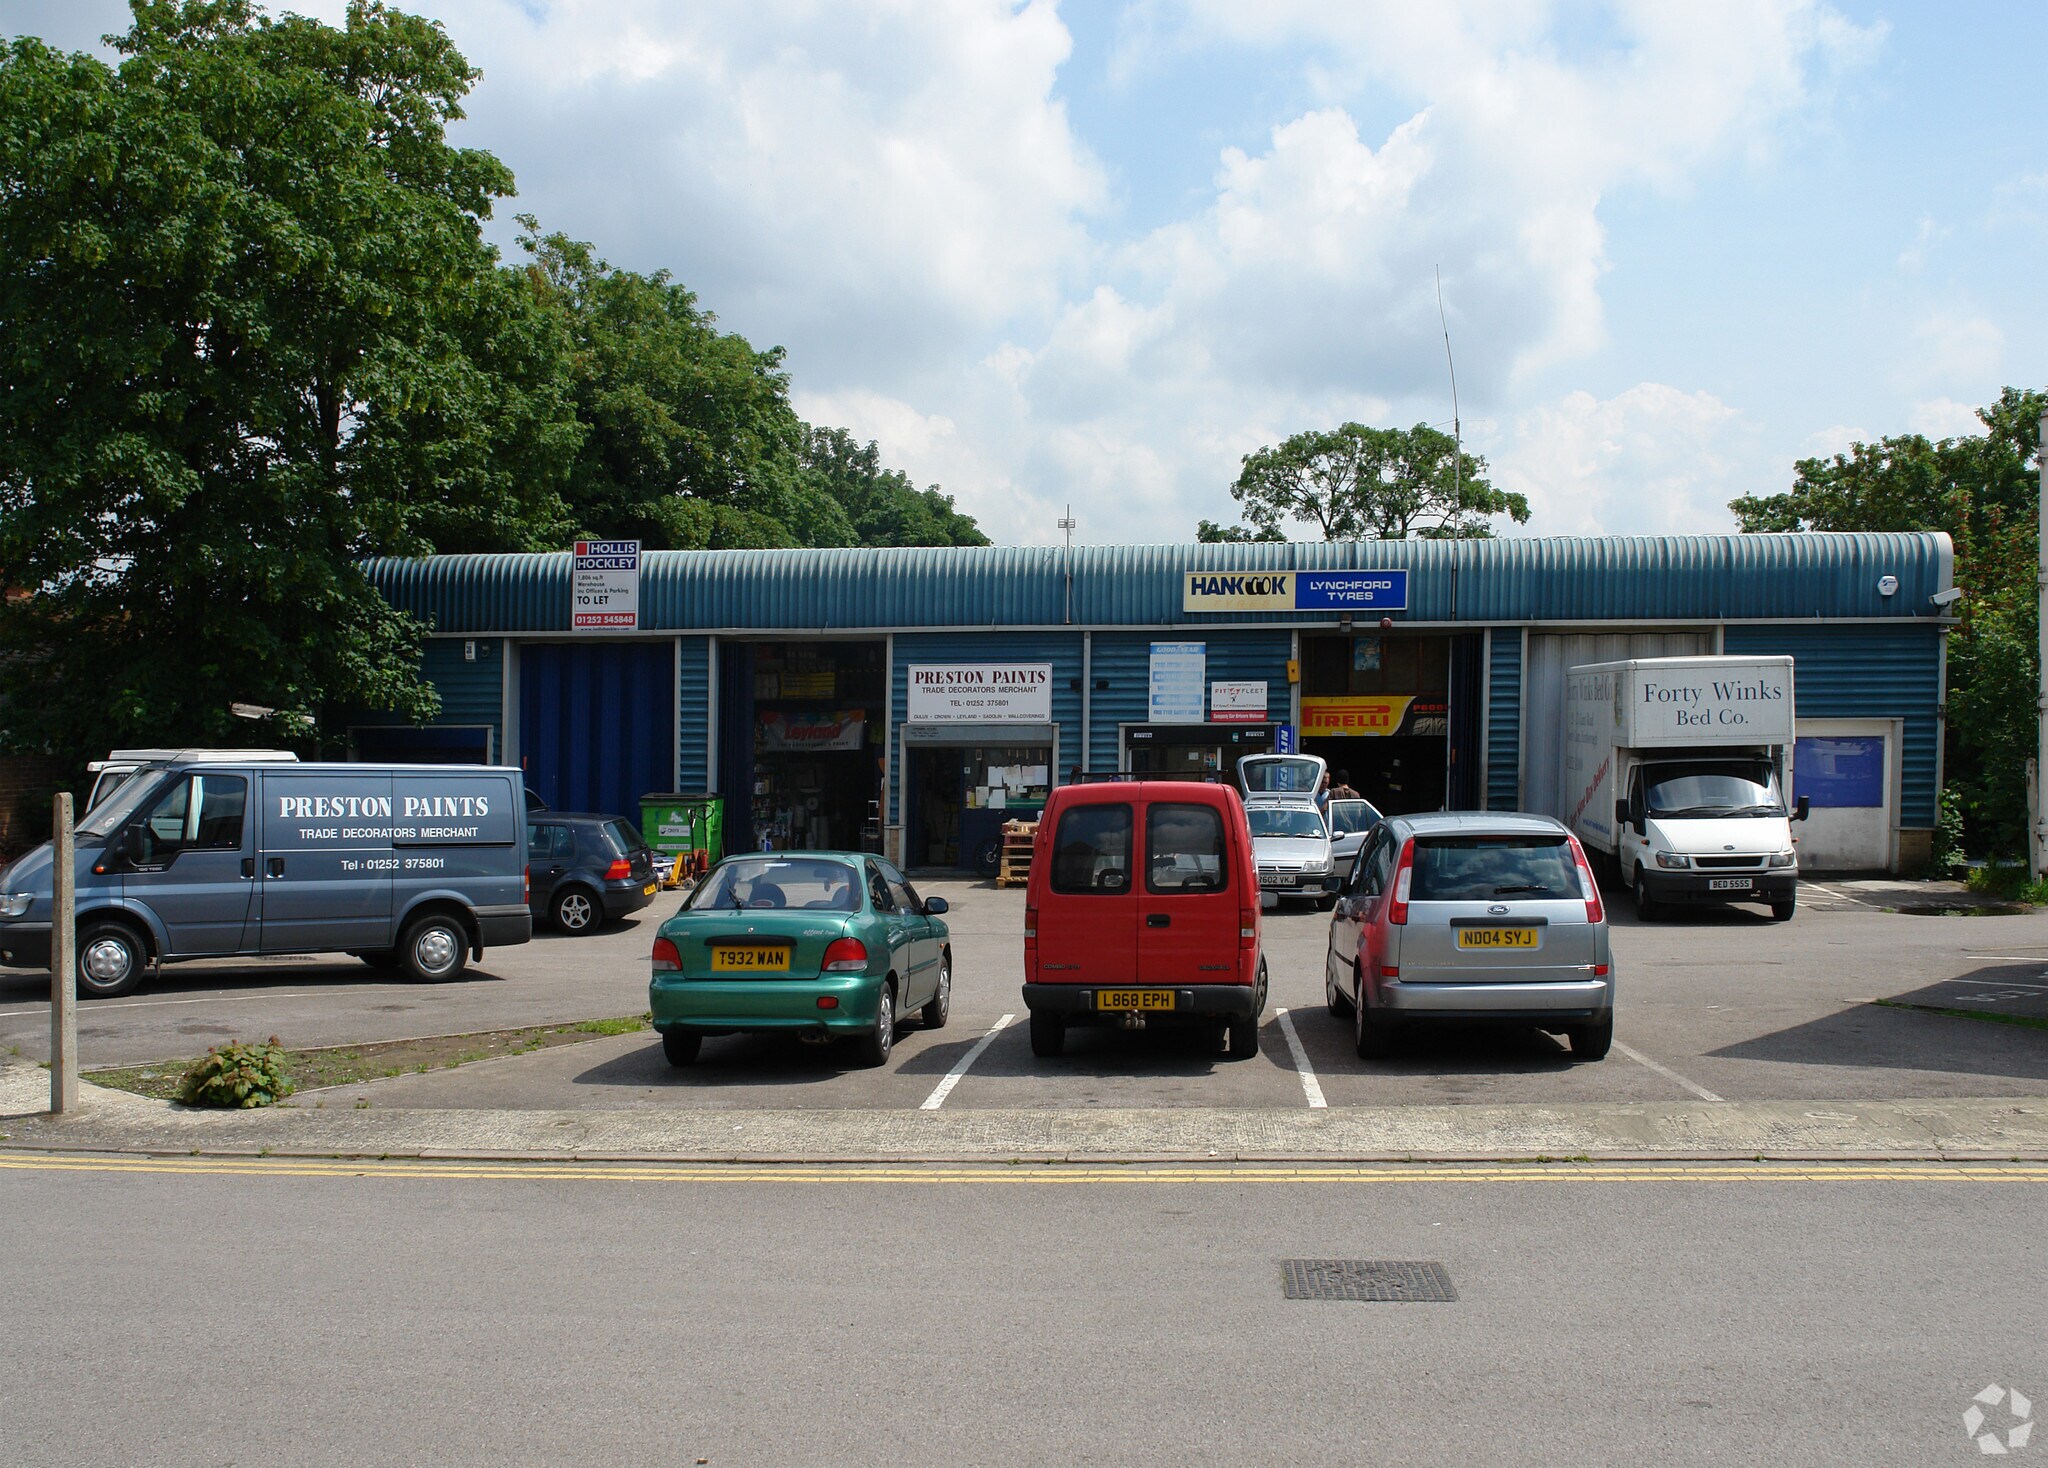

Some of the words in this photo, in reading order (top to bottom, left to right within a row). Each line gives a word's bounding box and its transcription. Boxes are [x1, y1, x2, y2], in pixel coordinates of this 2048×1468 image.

[591, 543, 635, 554] HOLLIS
[577, 558, 634, 569] HOCKLEY
[1191, 576, 1287, 596] HANKOOK
[1310, 580, 1392, 590] LYNCHFORD
[577, 595, 591, 605] TO
[593, 595, 609, 605] LET
[1327, 591, 1374, 601] TYRES
[576, 615, 602, 624] 01252
[603, 615, 634, 624] 545848
[914, 670, 984, 684] PRESTON
[992, 670, 1046, 683] PAINTS
[1643, 683, 1703, 709] Forty
[1712, 680, 1782, 701] Winks
[1302, 705, 1391, 727] PIRELLI
[1676, 708, 1711, 725] Bed
[1719, 708, 1749, 725] Co.
[783, 721, 844, 741] Leyland
[279, 796, 393, 818] PRESTON
[403, 796, 489, 817] PAINTS
[299, 828, 338, 839] TRADE
[342, 827, 416, 839] DECORATORS
[420, 826, 479, 838] MERCHANT
[366, 859, 400, 870] 01252
[404, 858, 445, 869] 375801
[1279, 874, 1296, 883] VKJ
[1712, 880, 1728, 889] BED
[1463, 931, 1500, 945] ND04
[1504, 931, 1532, 945] SYJ
[719, 951, 755, 966] T932
[757, 951, 784, 965] WAN
[1103, 993, 1139, 1007] L868
[1142, 993, 1170, 1006] EPH
